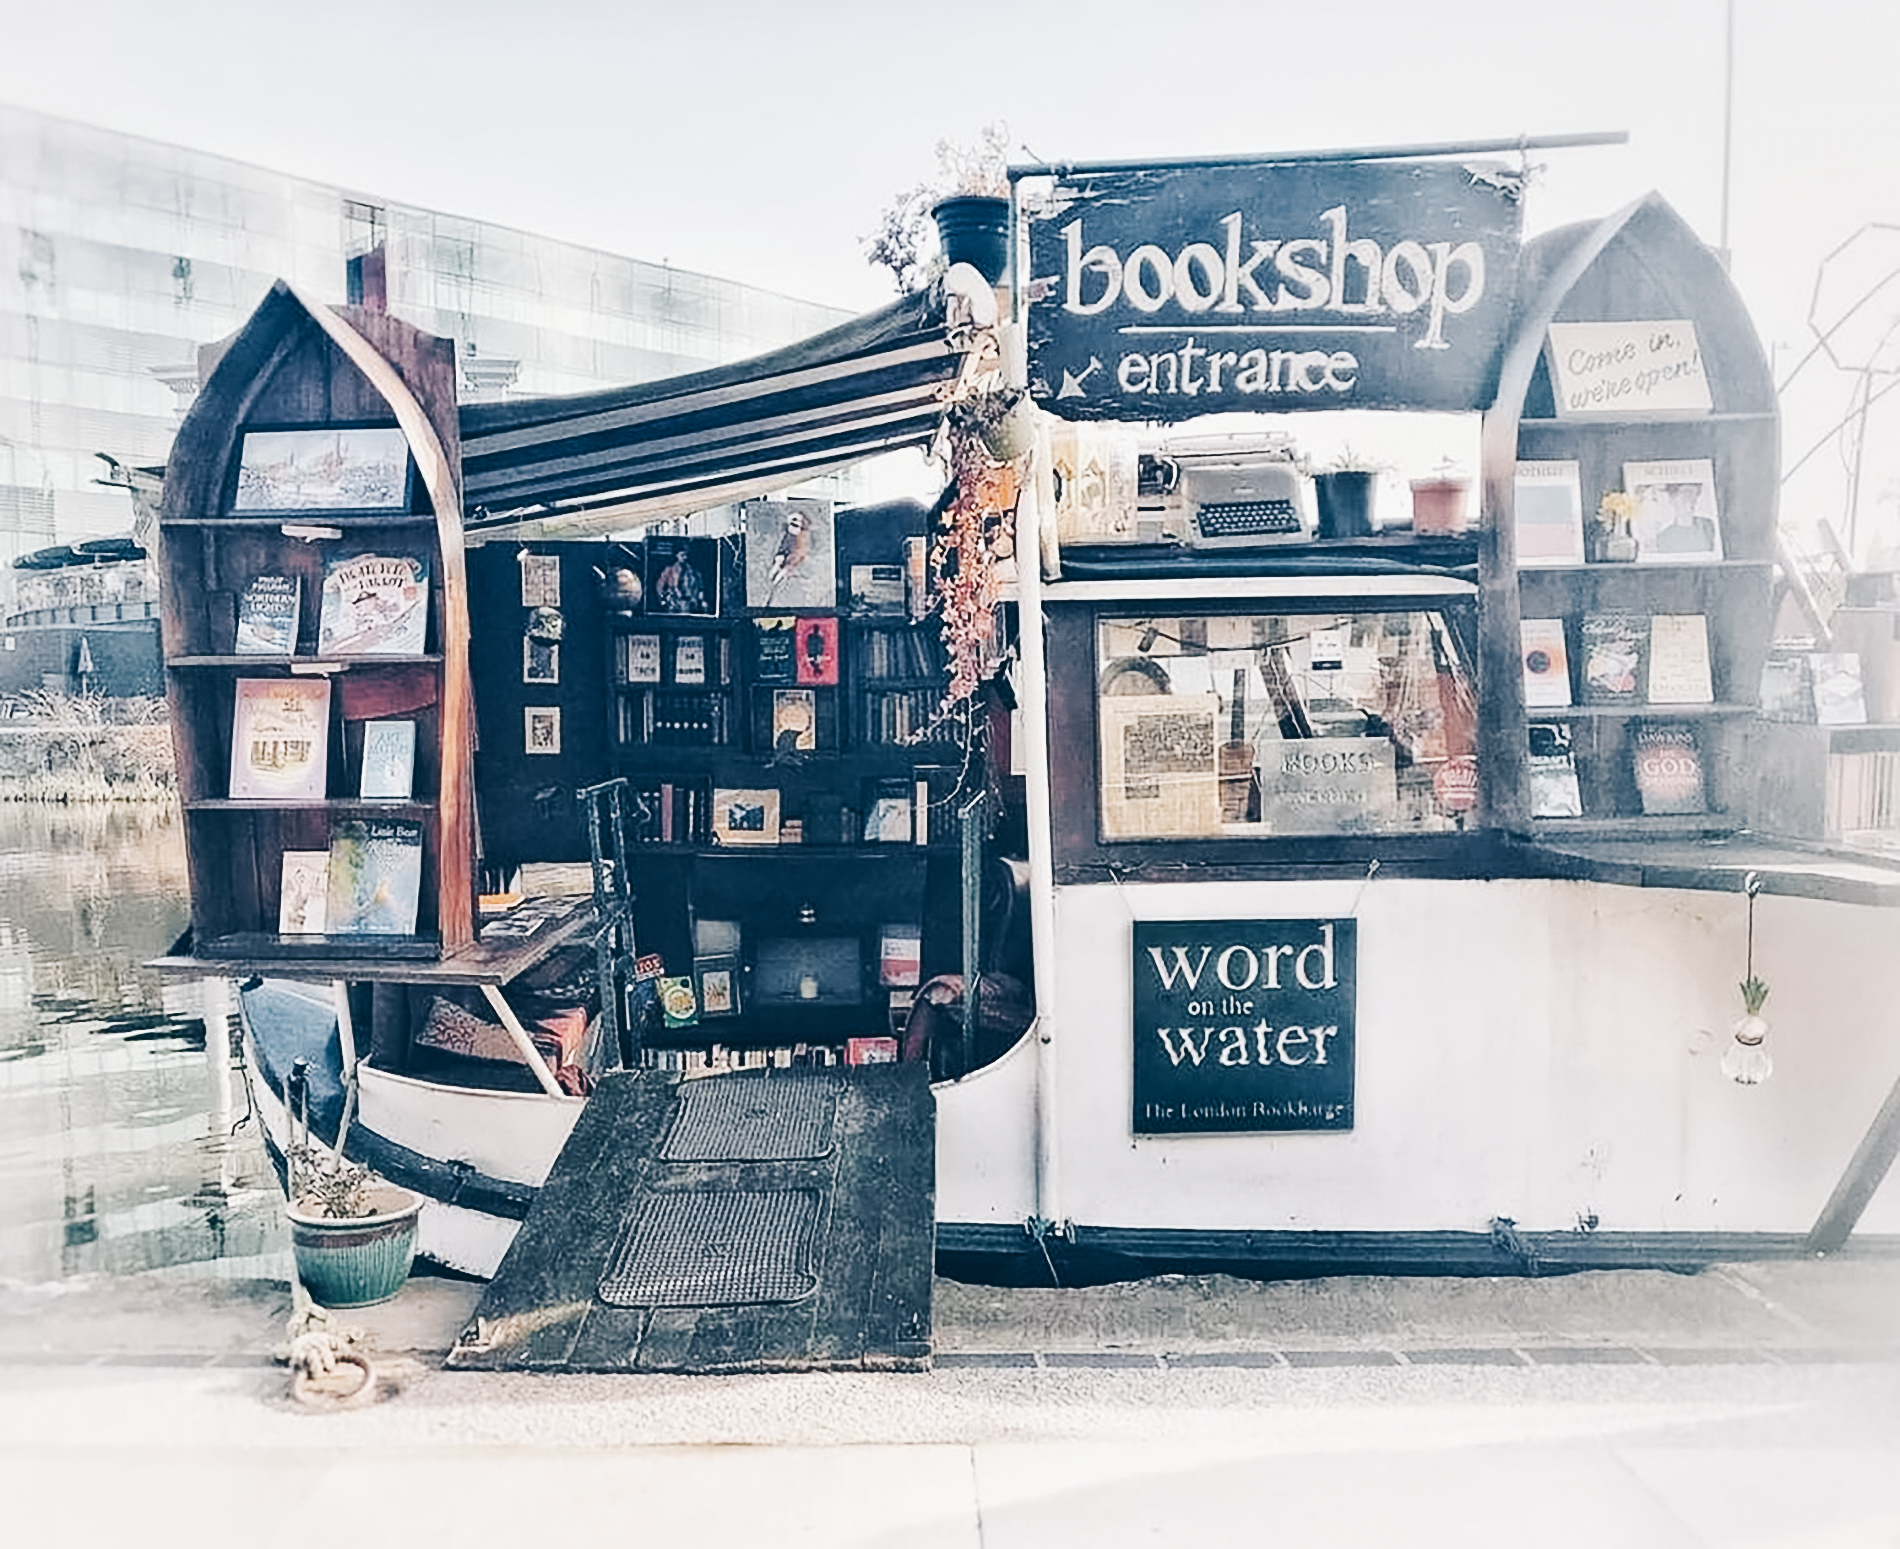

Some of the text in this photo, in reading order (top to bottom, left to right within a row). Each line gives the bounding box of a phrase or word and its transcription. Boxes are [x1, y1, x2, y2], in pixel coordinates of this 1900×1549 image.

[1059, 205, 1485, 349] bookshop
[1117, 337, 1359, 395] entrance
[1568, 332, 1681, 375] Come in,
[1570, 351, 1699, 409] we're open!
[1642, 758, 1697, 776] GOD
[1147, 923, 1337, 990] word
[1187, 995, 1254, 1015] on the
[1157, 1018, 1338, 1067] water
[1146, 1103, 1174, 1118] The
[1181, 1102, 1246, 1118] London
